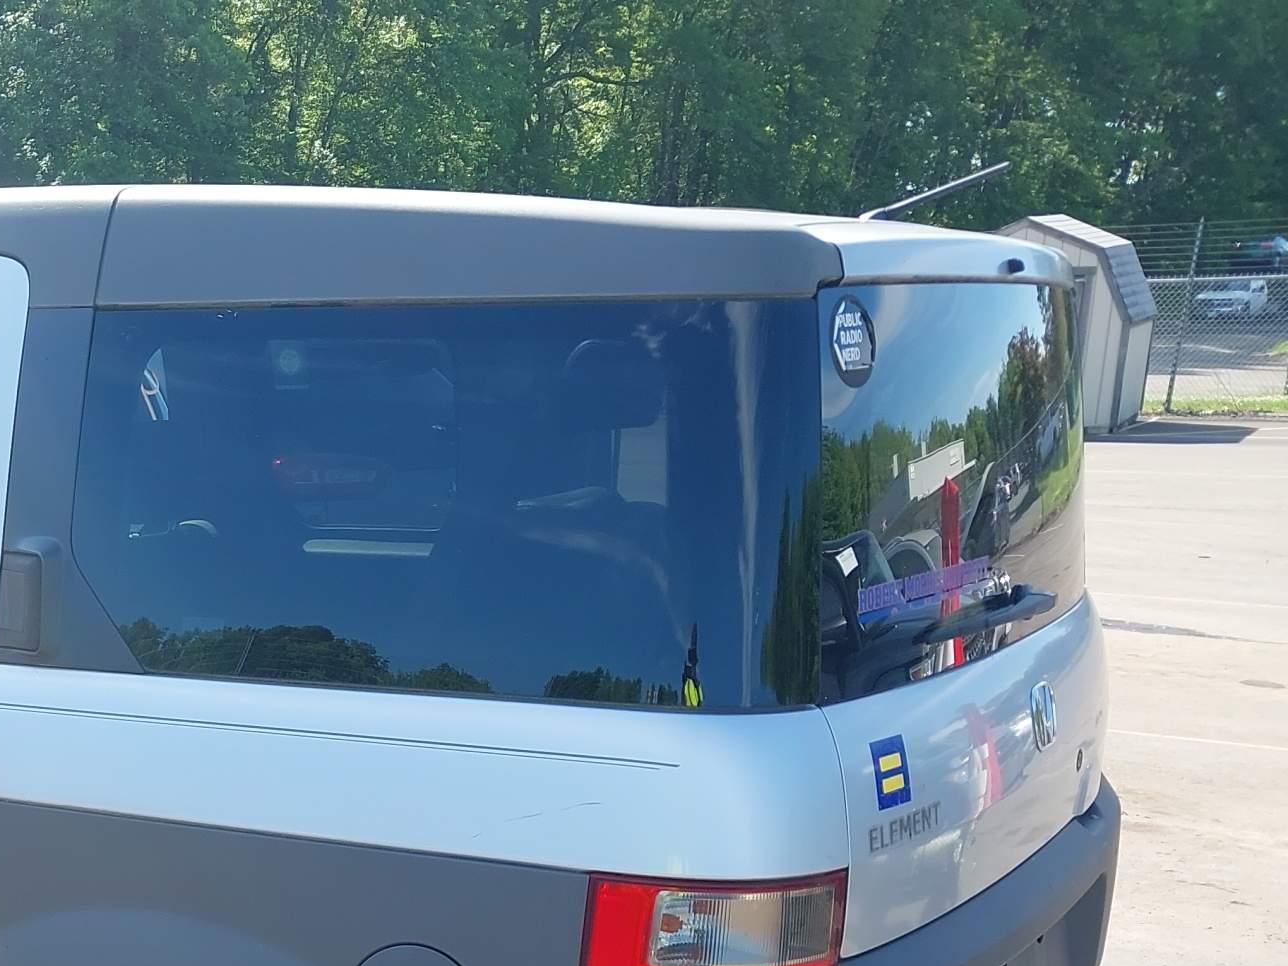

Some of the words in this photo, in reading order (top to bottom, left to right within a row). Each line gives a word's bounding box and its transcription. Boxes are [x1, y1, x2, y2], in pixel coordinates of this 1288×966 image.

[838, 312, 863, 328] PUBLIC
[840, 329, 863, 345] RADIO
[842, 347, 861, 362] NERD
[868, 800, 941, 854] ELEMENT
